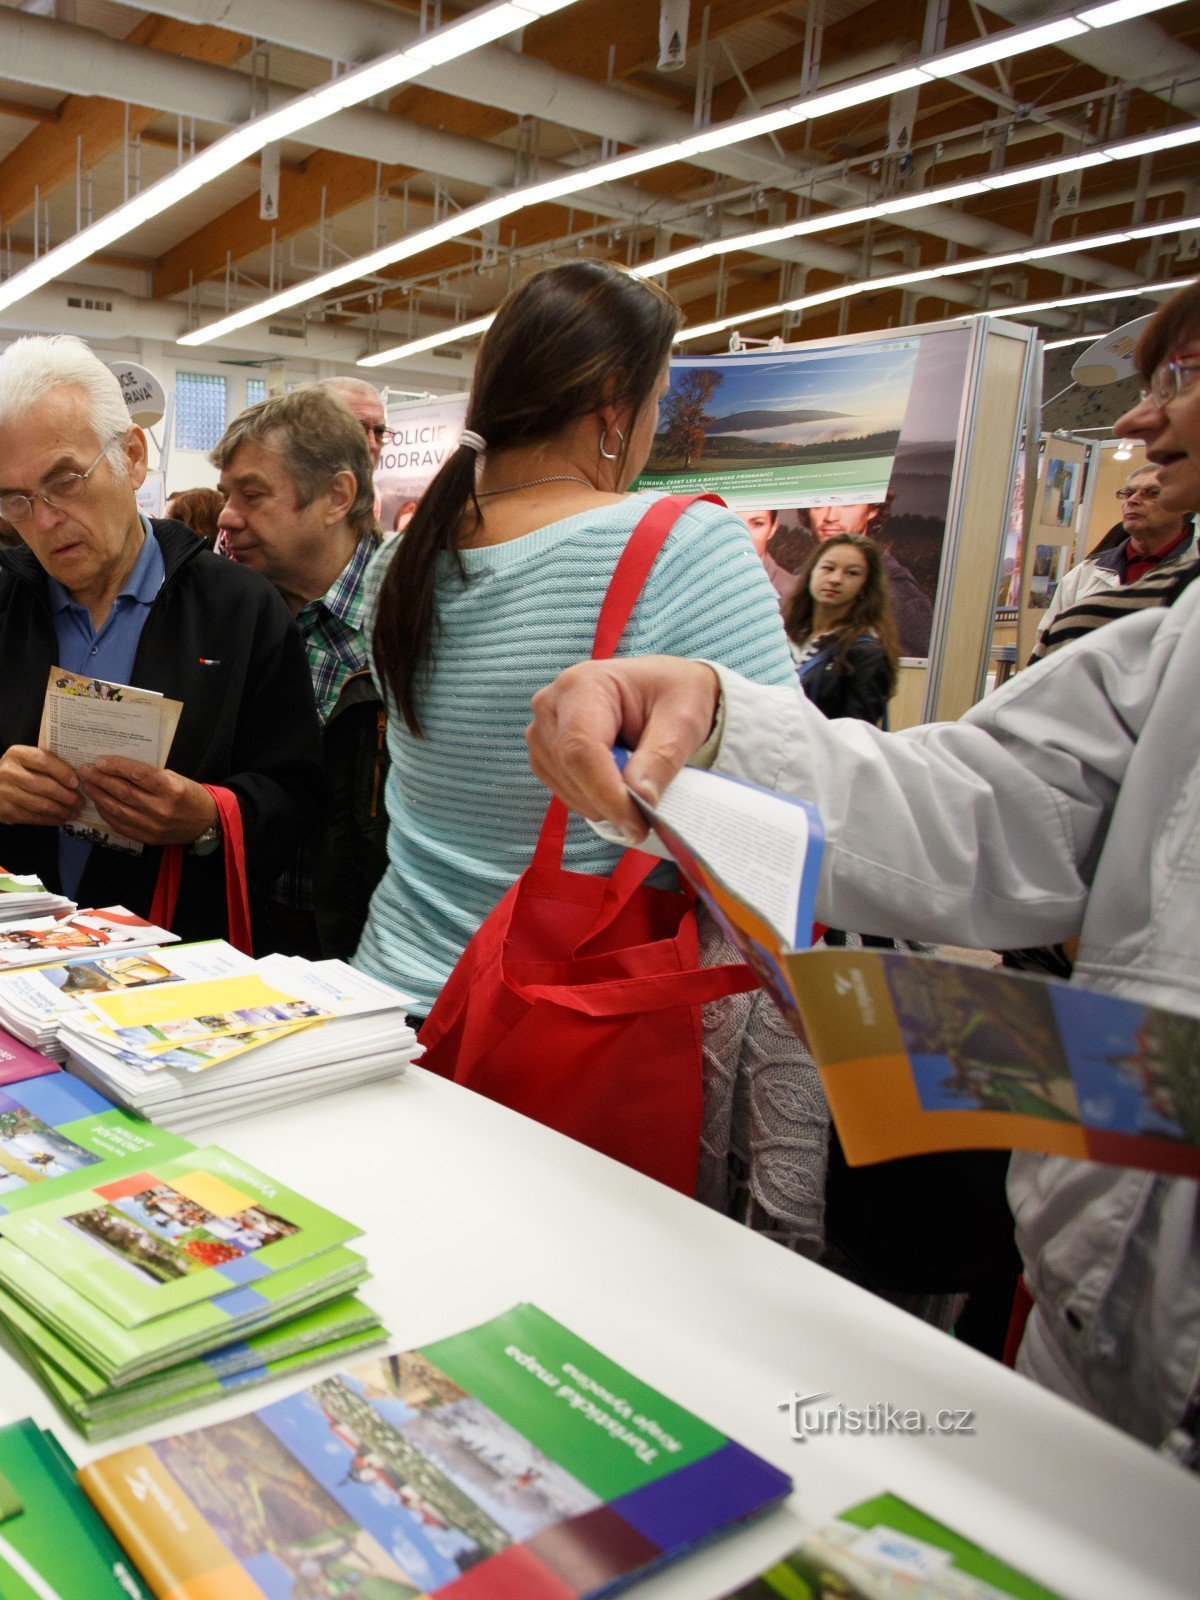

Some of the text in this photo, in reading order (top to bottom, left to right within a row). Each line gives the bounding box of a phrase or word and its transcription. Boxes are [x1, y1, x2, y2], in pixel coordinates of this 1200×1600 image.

[392, 425, 448, 447] OLICIE
[504, 1344, 658, 1465] Turistická mapa
[632, 1414, 683, 1454] Kraje
